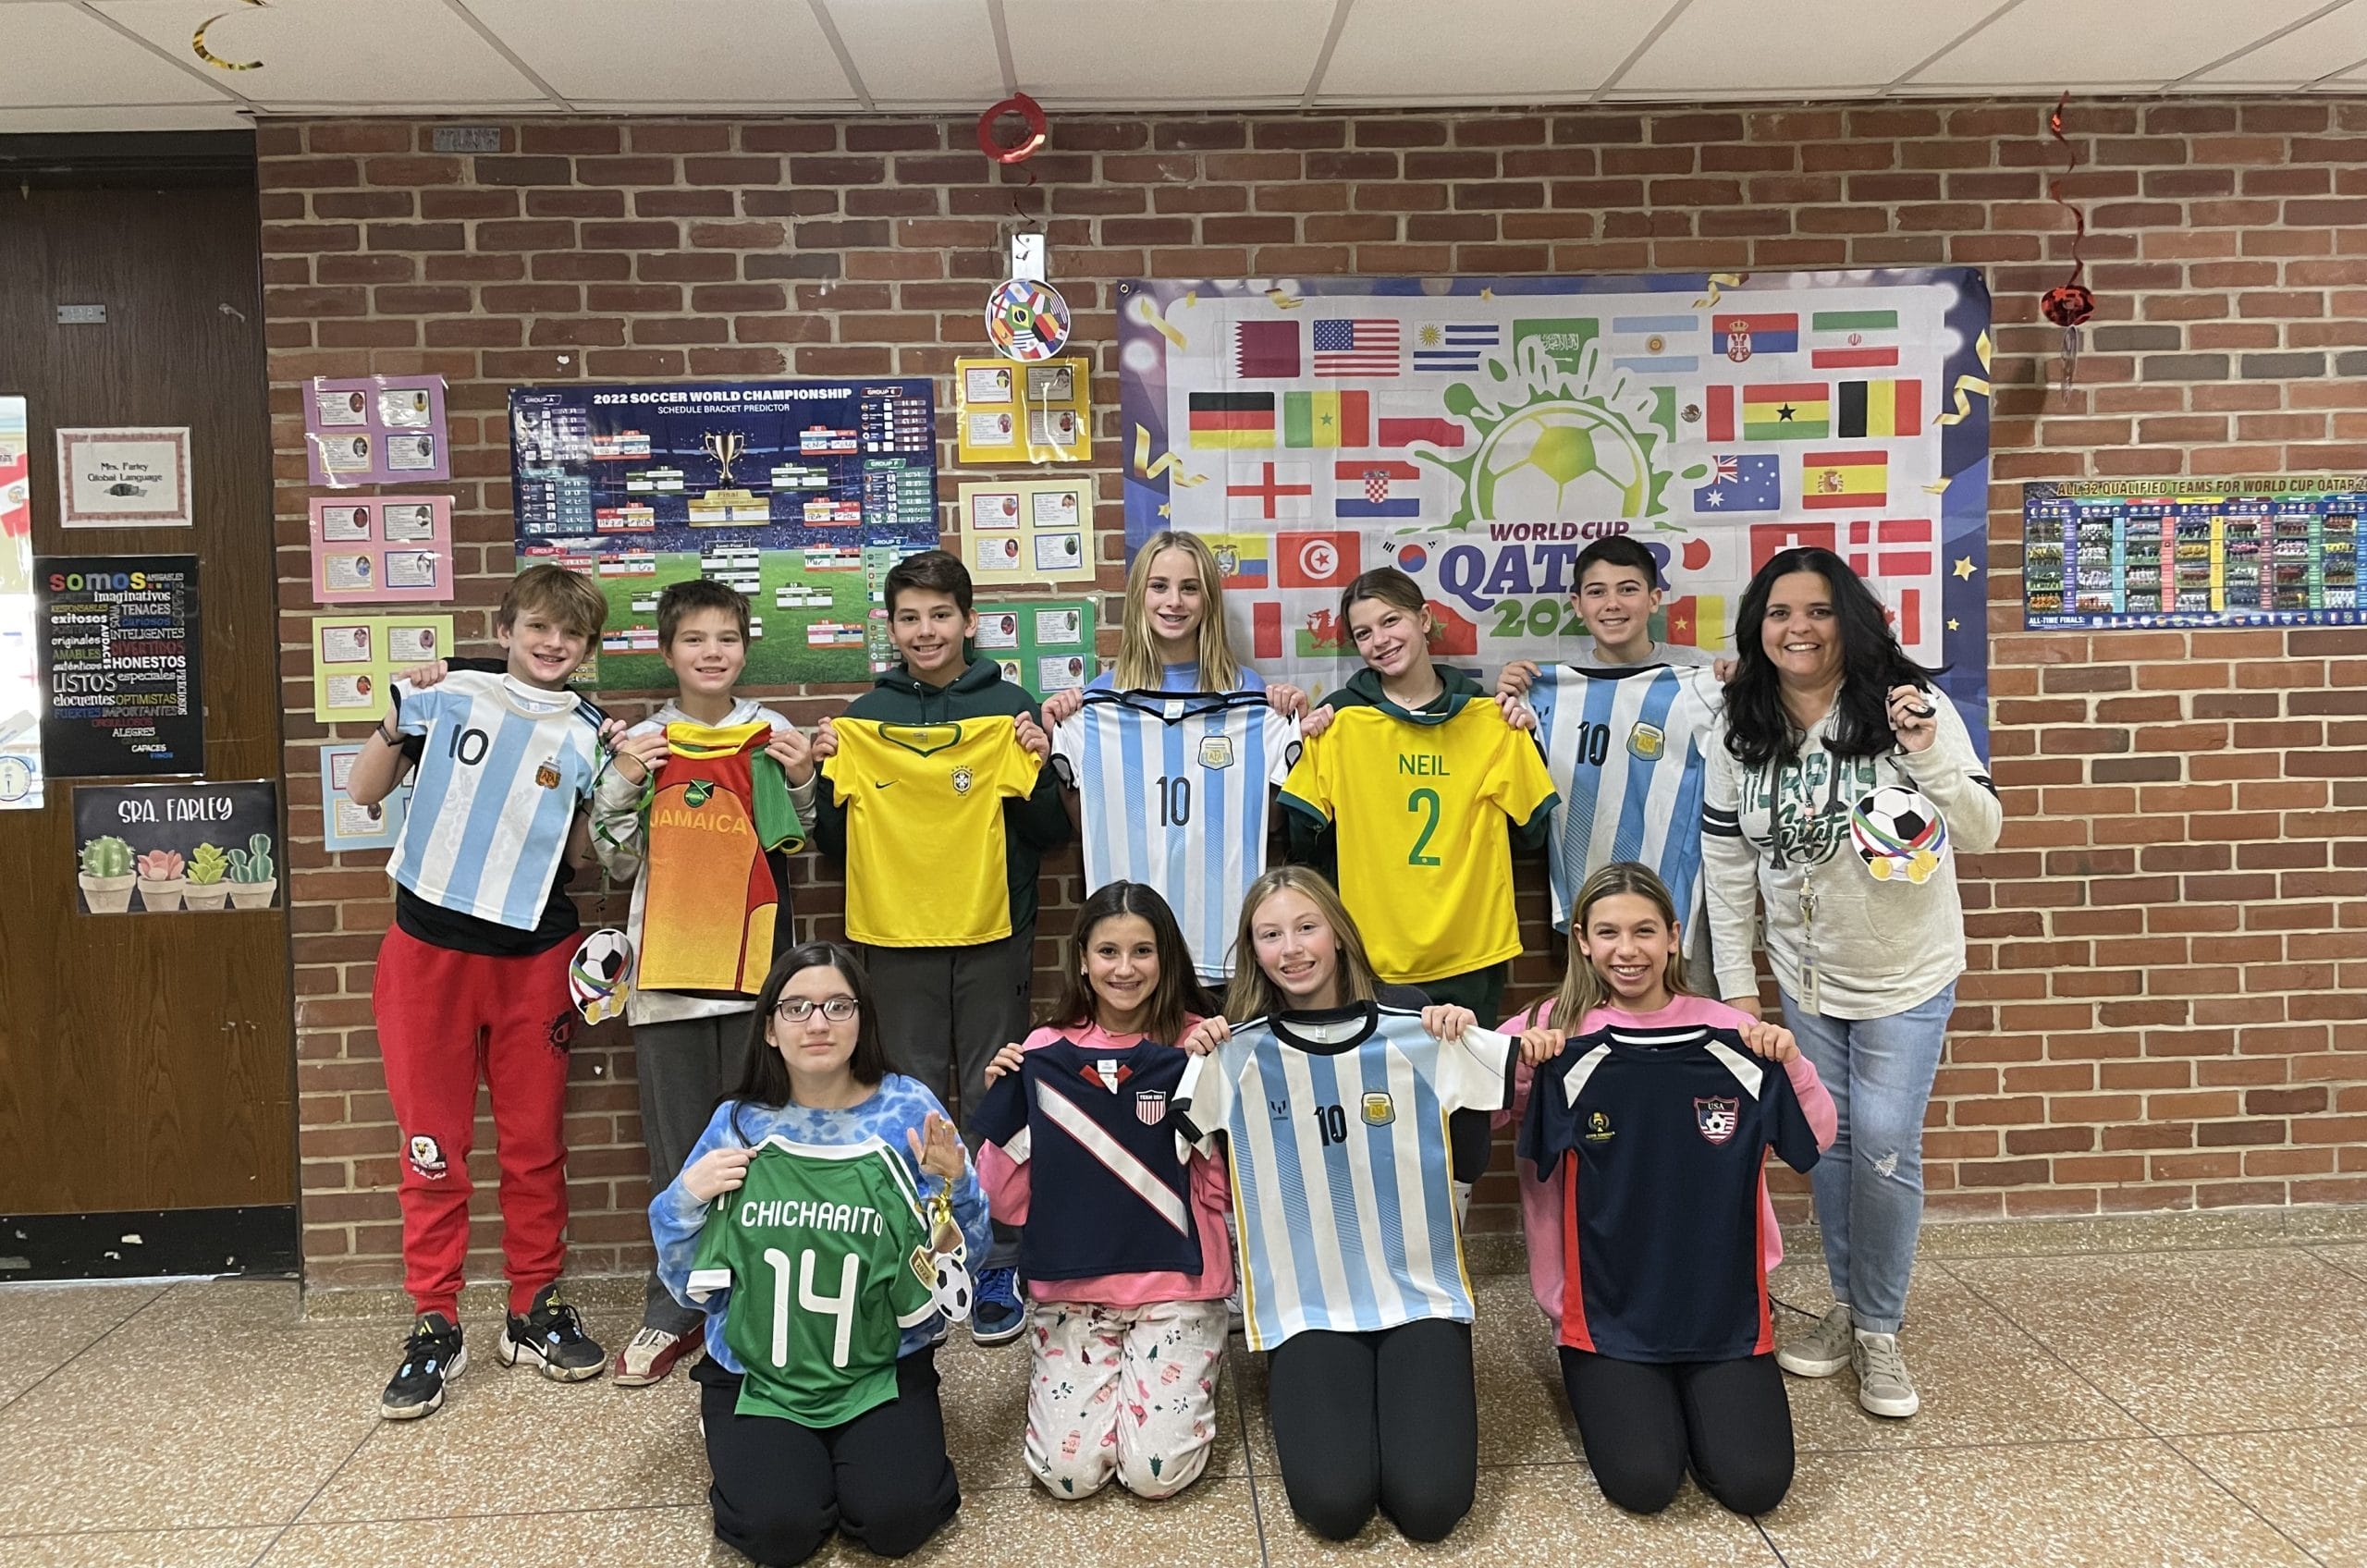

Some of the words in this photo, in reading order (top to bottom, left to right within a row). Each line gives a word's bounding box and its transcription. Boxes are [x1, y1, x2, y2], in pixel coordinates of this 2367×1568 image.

[594, 394, 628, 405] 2022
[630, 392, 687, 404] SOCCER
[689, 391, 741, 403] WORLD
[742, 388, 852, 401] CHAMPIONSHIP
[657, 405, 703, 415] SCHEDULE
[704, 404, 741, 414] BRACKET
[743, 403, 790, 412] PREDICTOR
[101, 462, 119, 472] Mrs.
[122, 462, 149, 472] Farley
[88, 472, 117, 482] Global
[119, 472, 163, 483] Language
[2057, 483, 2079, 496] ALL
[2084, 484, 2098, 495] 32
[2103, 482, 2167, 496] QUALIFIED
[2172, 481, 2213, 494] TEAMS
[2216, 481, 2240, 493] FOR
[2244, 480, 2287, 492] WORLD
[2289, 479, 2314, 491] CUP
[2317, 479, 2354, 491] QATAR
[1489, 522, 1577, 542] WORLD
[1580, 521, 1630, 540] CUP
[93, 589, 171, 604] imaginativos
[51, 604, 109, 613] RESPONSABLES
[121, 603, 171, 616] TENACES
[51, 612, 108, 625] exitosos
[120, 617, 171, 627] curiosos
[2028, 617, 2058, 625] ALL-TIME
[51, 633, 101, 649] originales
[110, 627, 185, 640] INTELIGENTES
[53, 648, 102, 660] AMABLES
[100, 624, 112, 669] AUDACES
[111, 640, 185, 655] DIVERTIDOS
[112, 655, 186, 669] HONESTOS
[53, 672, 118, 693] LISTOS
[117, 668, 176, 684] especiales
[116, 693, 178, 705] OPTIMISTAS
[176, 668, 188, 716] PRECIOSOS
[53, 693, 116, 707] elocuentes
[54, 706, 102, 719] FUERTES
[102, 705, 178, 717] IMPORTANTES
[112, 727, 155, 738] ALEGRES
[131, 743, 166, 753] CAPACES
[448, 723, 489, 766] 10
[1576, 721, 1611, 767] 10
[1398, 753, 1451, 776] NEIL
[1155, 776, 1191, 827] 10
[117, 798, 160, 824] SRA.
[166, 796, 233, 822] FARLEY
[649, 808, 748, 836] JAMAICA
[1407, 788, 1441, 866] 2
[1313, 1104, 1348, 1147] 10
[763, 1247, 860, 1368] 14
